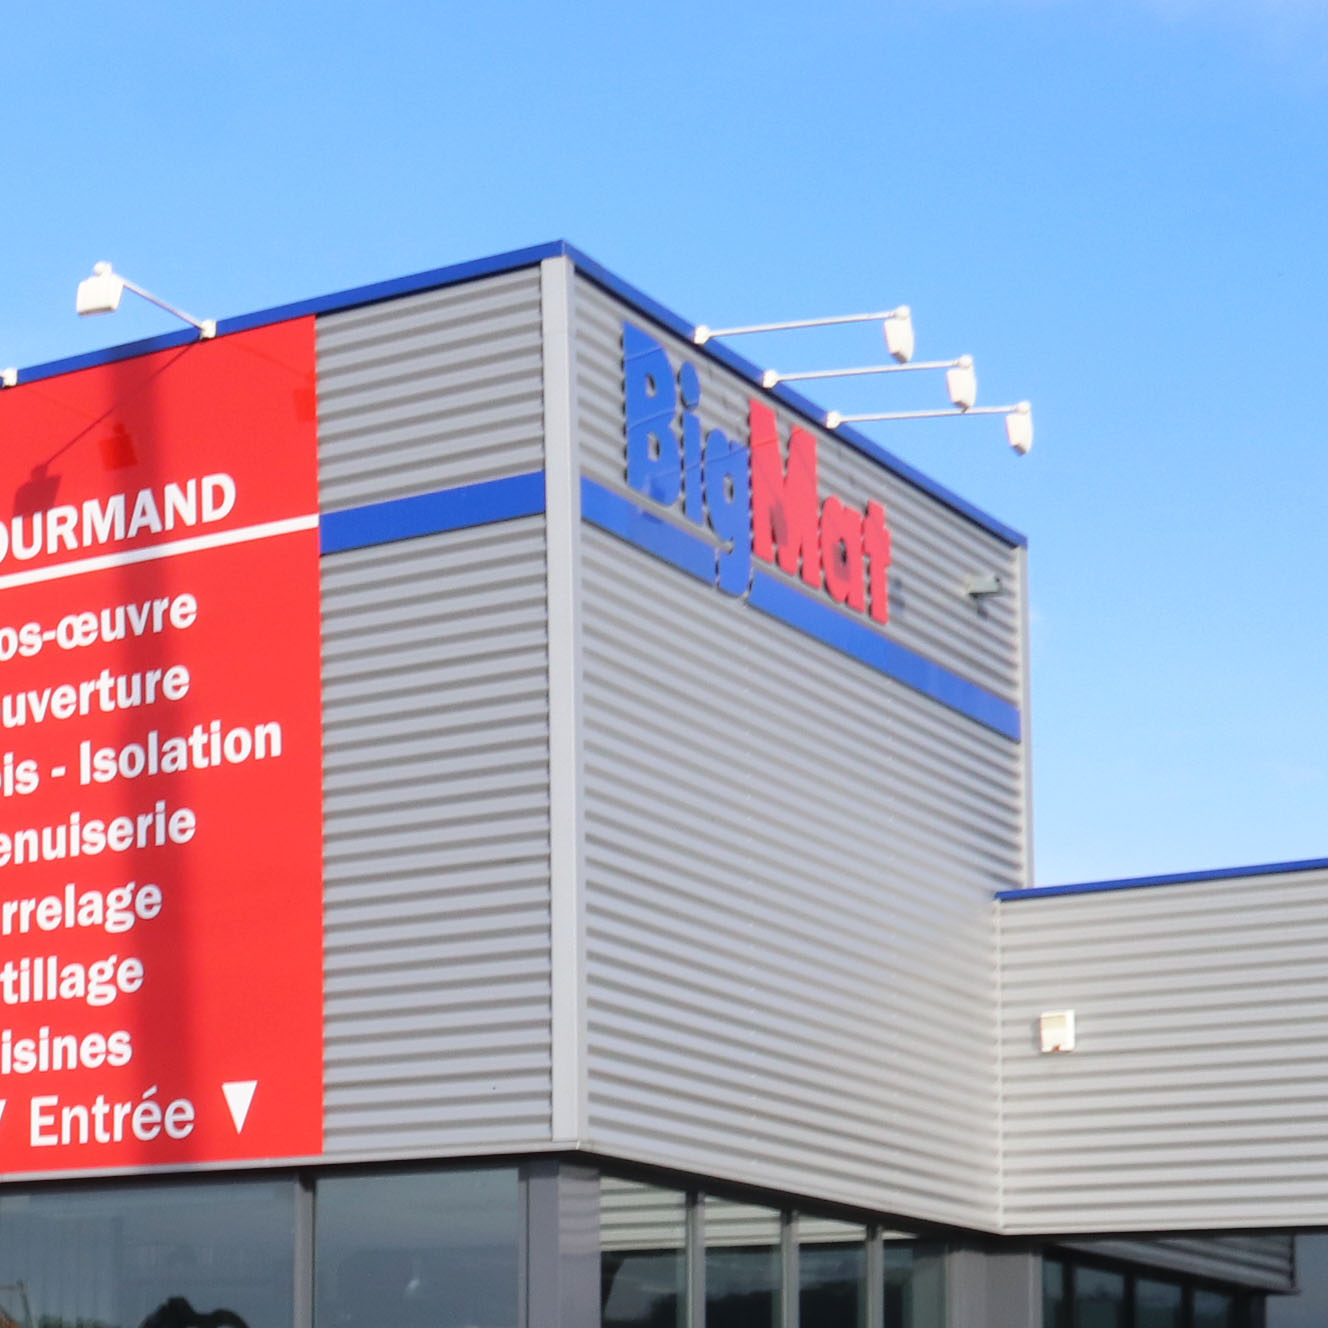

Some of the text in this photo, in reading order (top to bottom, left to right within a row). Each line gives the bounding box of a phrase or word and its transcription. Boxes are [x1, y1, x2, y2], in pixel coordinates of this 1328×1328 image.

[622, 320, 891, 626] BigMat
[79, 719, 283, 785] Isolation
[30, 1085, 195, 1147] Entrée
